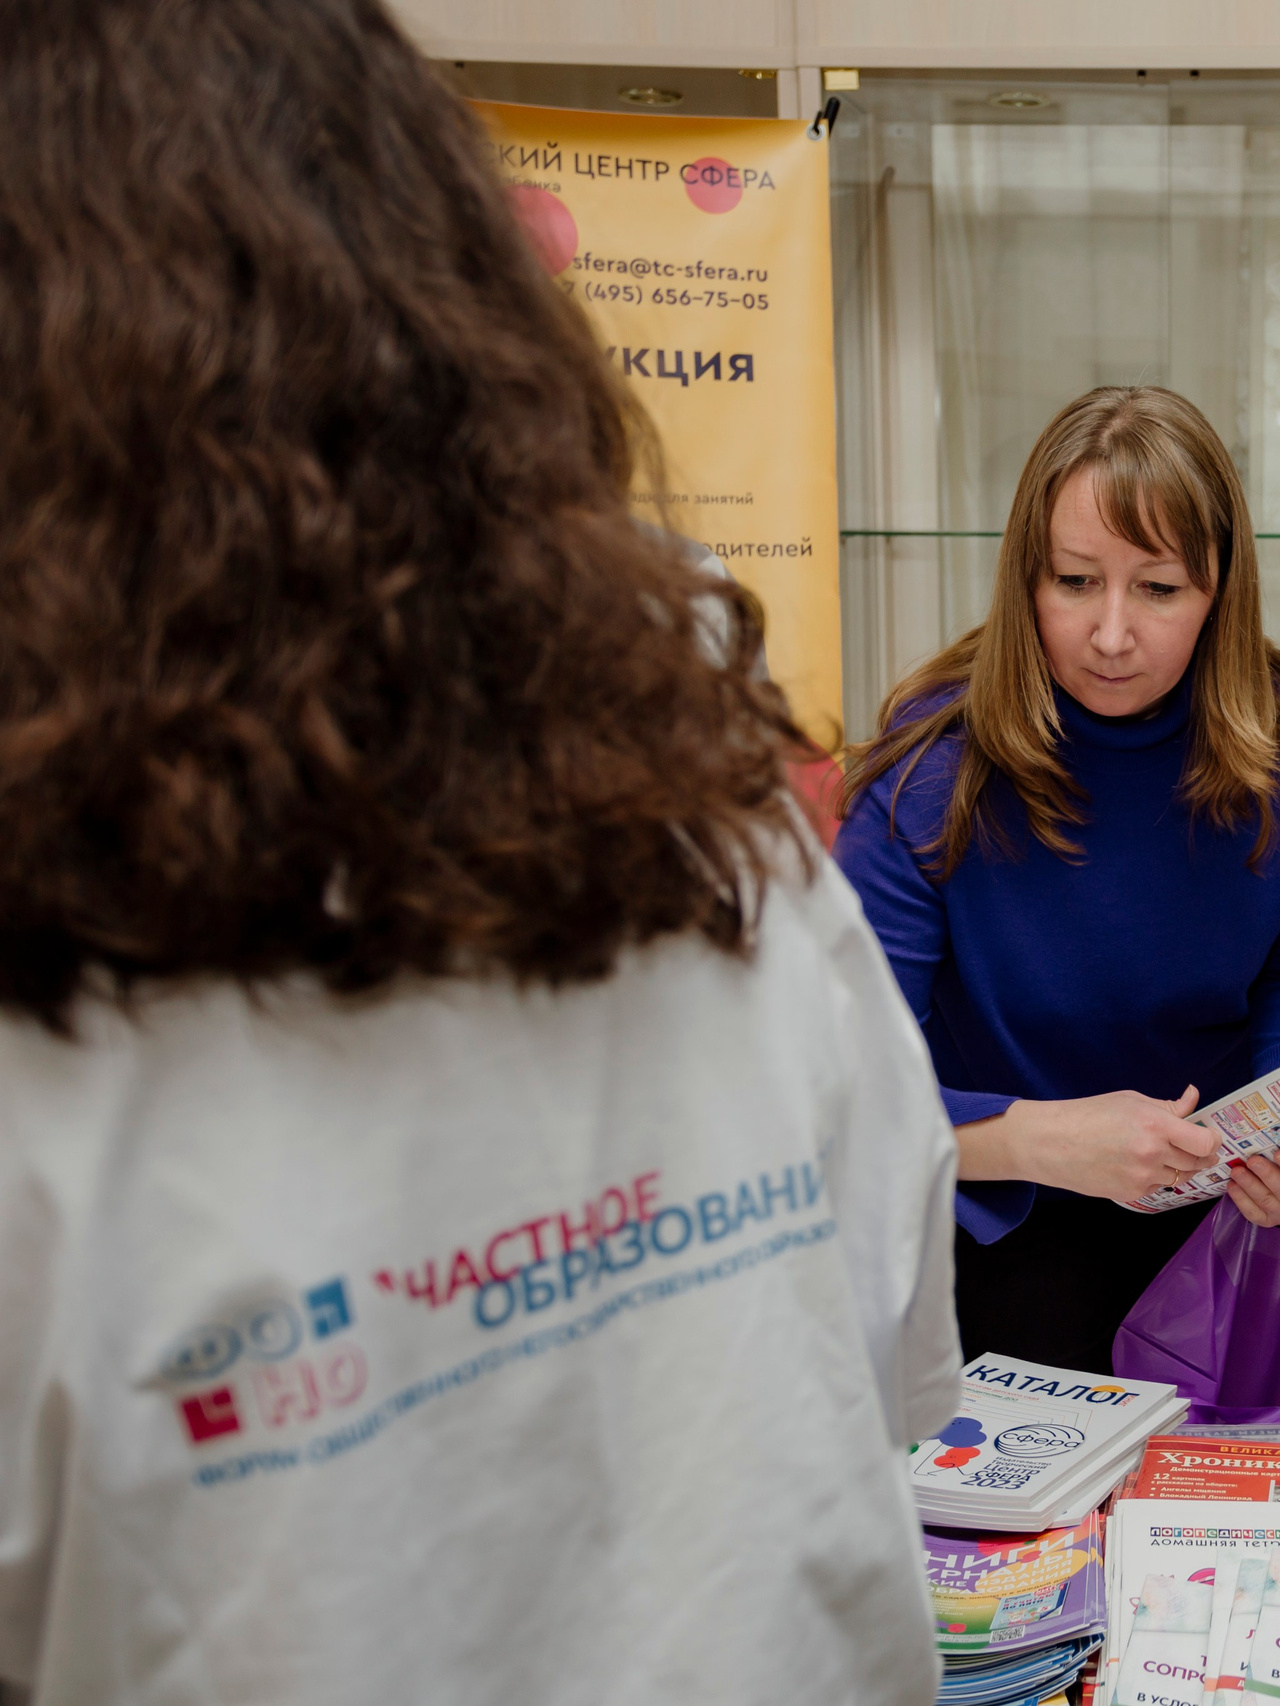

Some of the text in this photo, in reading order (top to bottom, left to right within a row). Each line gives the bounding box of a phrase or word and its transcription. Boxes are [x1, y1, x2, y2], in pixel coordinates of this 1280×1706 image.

[574, 152, 670, 182] ЦЕНТР
[681, 163, 776, 190] СФЕРА
[573, 251, 768, 283] sfera@tc-sfera.ru
[585, 281, 643, 305] (495)
[966, 1364, 1141, 1407] КАТАЛОГ
[1002, 1431, 1082, 1449] сфера
[990, 1459, 1048, 1470] Творческий
[995, 1455, 1053, 1467] Издательство
[974, 1469, 1032, 1482] СФЕРА
[982, 1463, 1041, 1476] Центр
[1153, 1472, 1170, 1480] 12
[1170, 1466, 1260, 1477] Демонстрационные
[960, 1475, 1030, 1490] 2023
[1151, 1537, 1237, 1548] домашняя
[923, 1531, 1075, 1569] НИГИ
[927, 1559, 1073, 1587] КИЕ ИЗДАНИЯ
[1271, 1669, 1280, 1679] В
[1136, 1692, 1146, 1702] В
